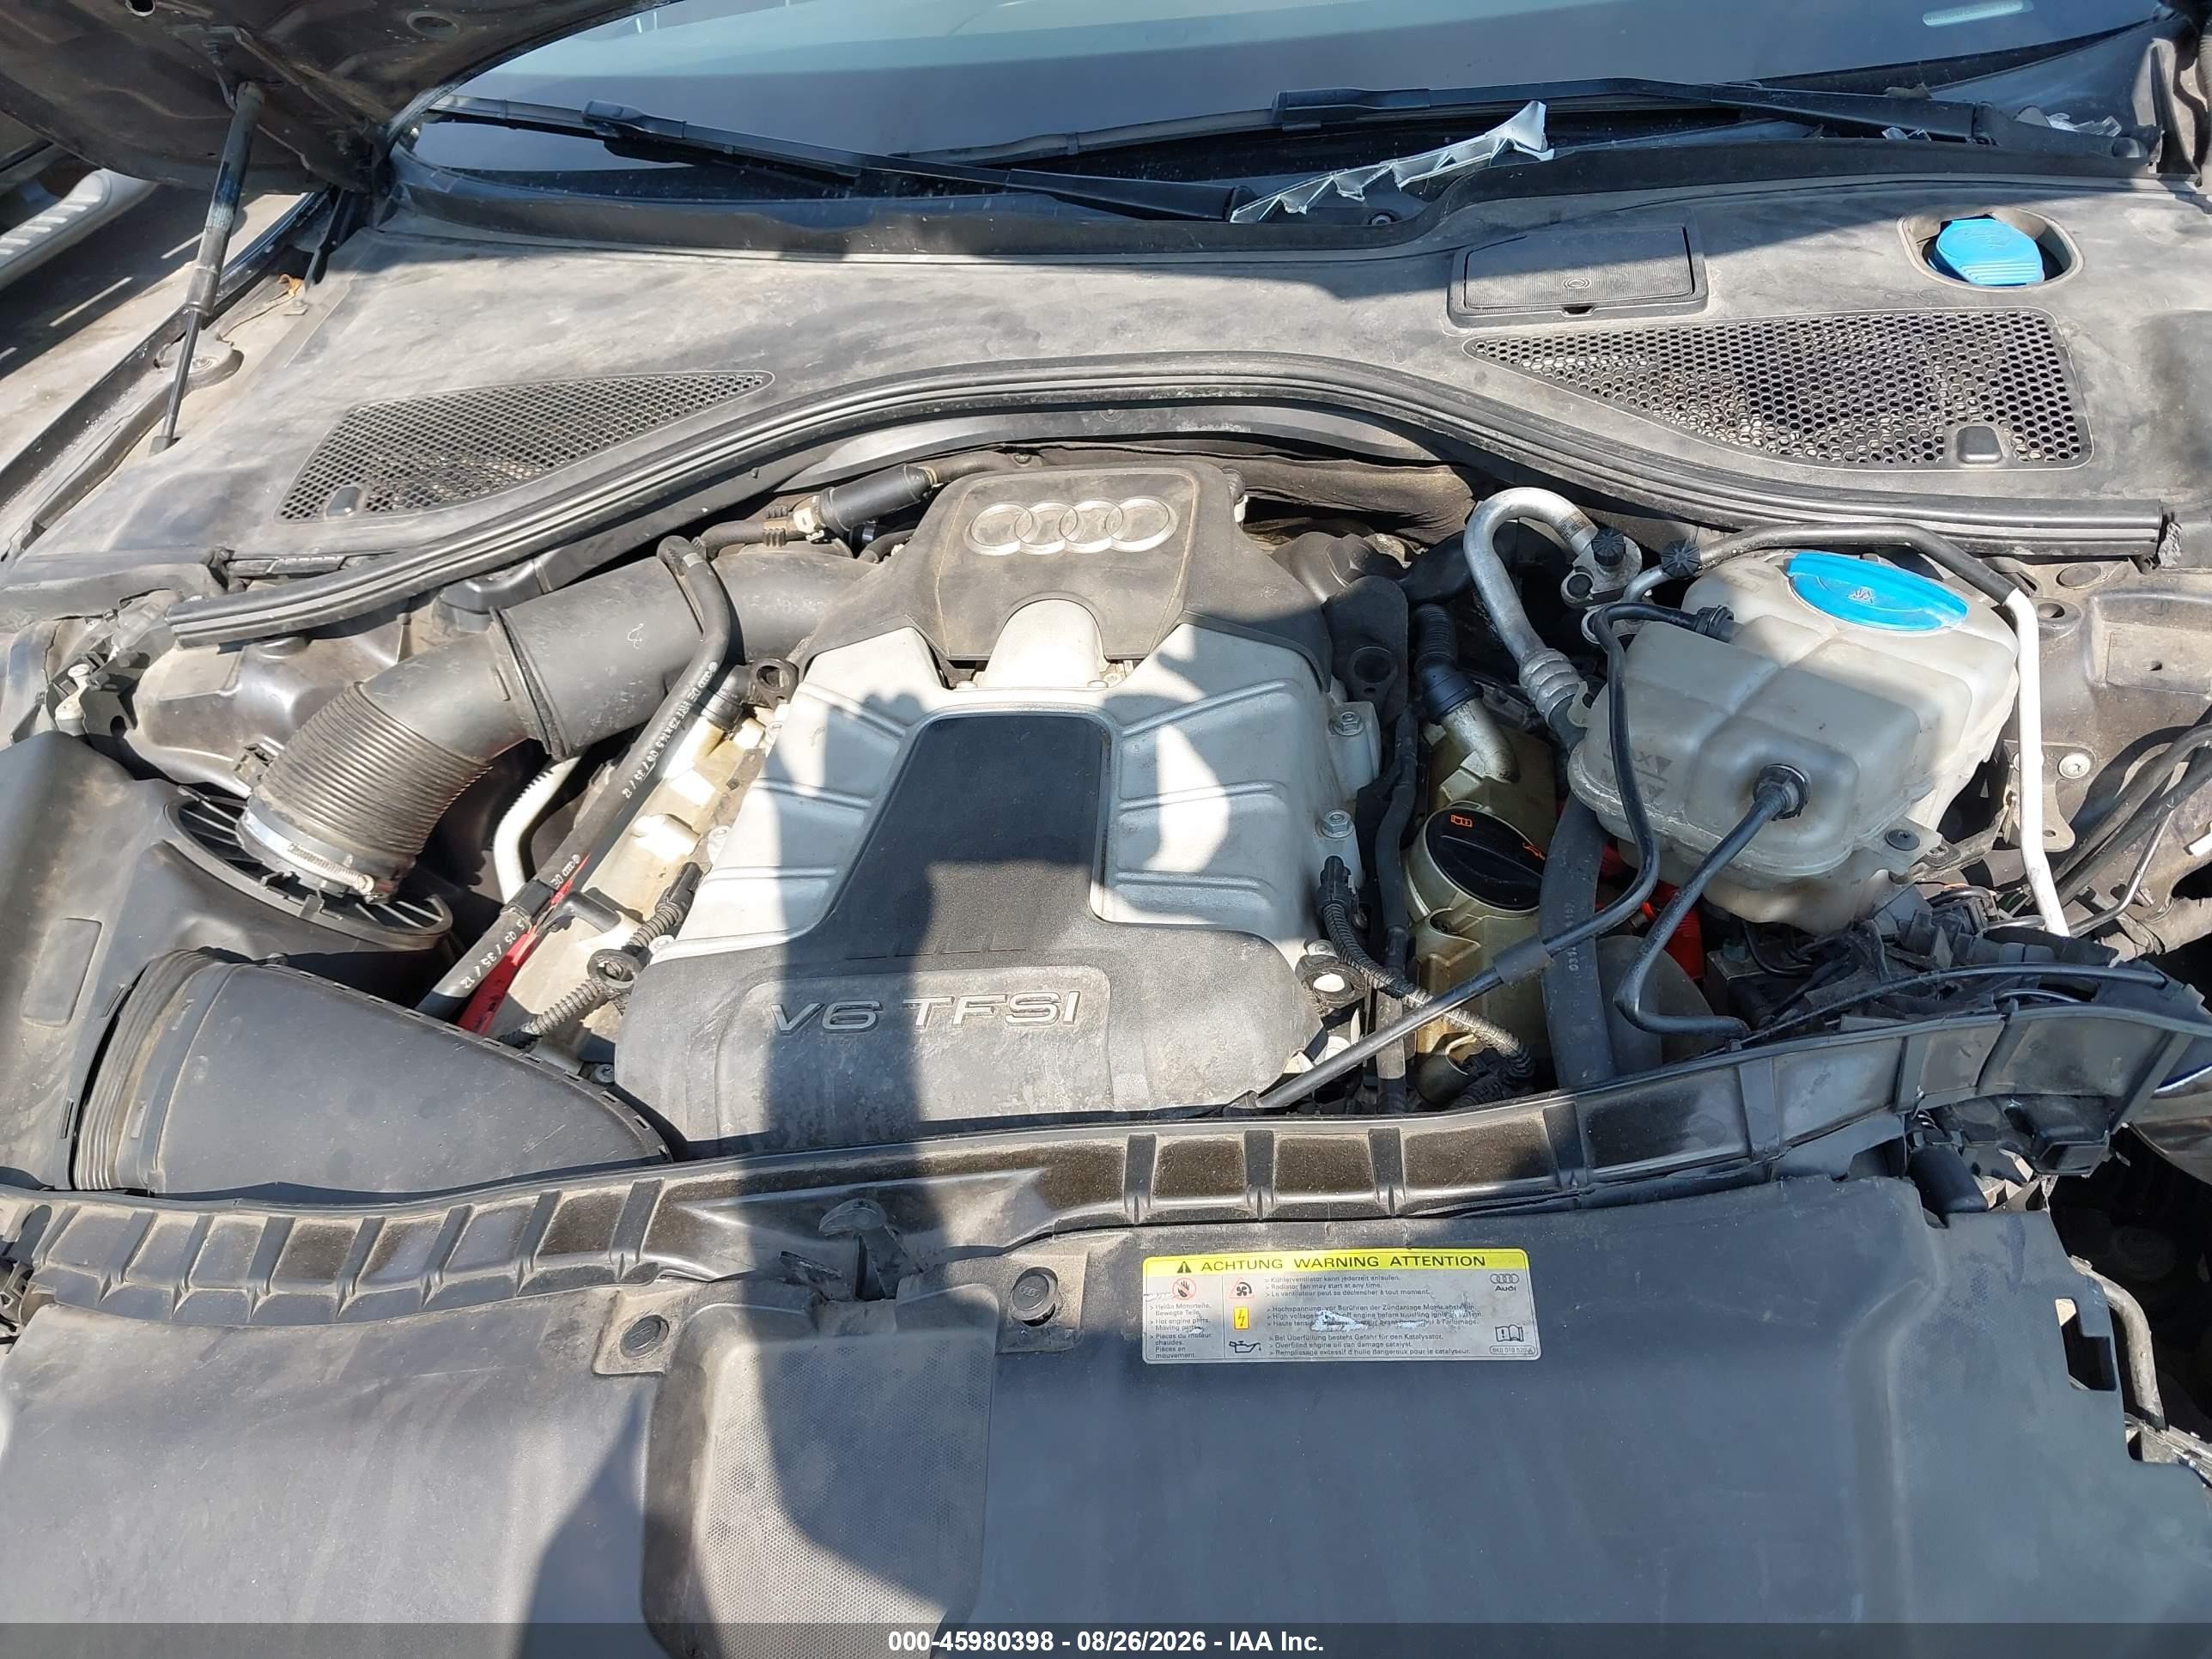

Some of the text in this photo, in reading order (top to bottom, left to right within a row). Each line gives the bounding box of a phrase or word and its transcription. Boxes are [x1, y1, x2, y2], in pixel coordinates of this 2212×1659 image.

[770, 990, 1082, 1036] V6 TFSI
[1200, 1255, 1486, 1272] ACHTUNG WARNING ATTENTION
